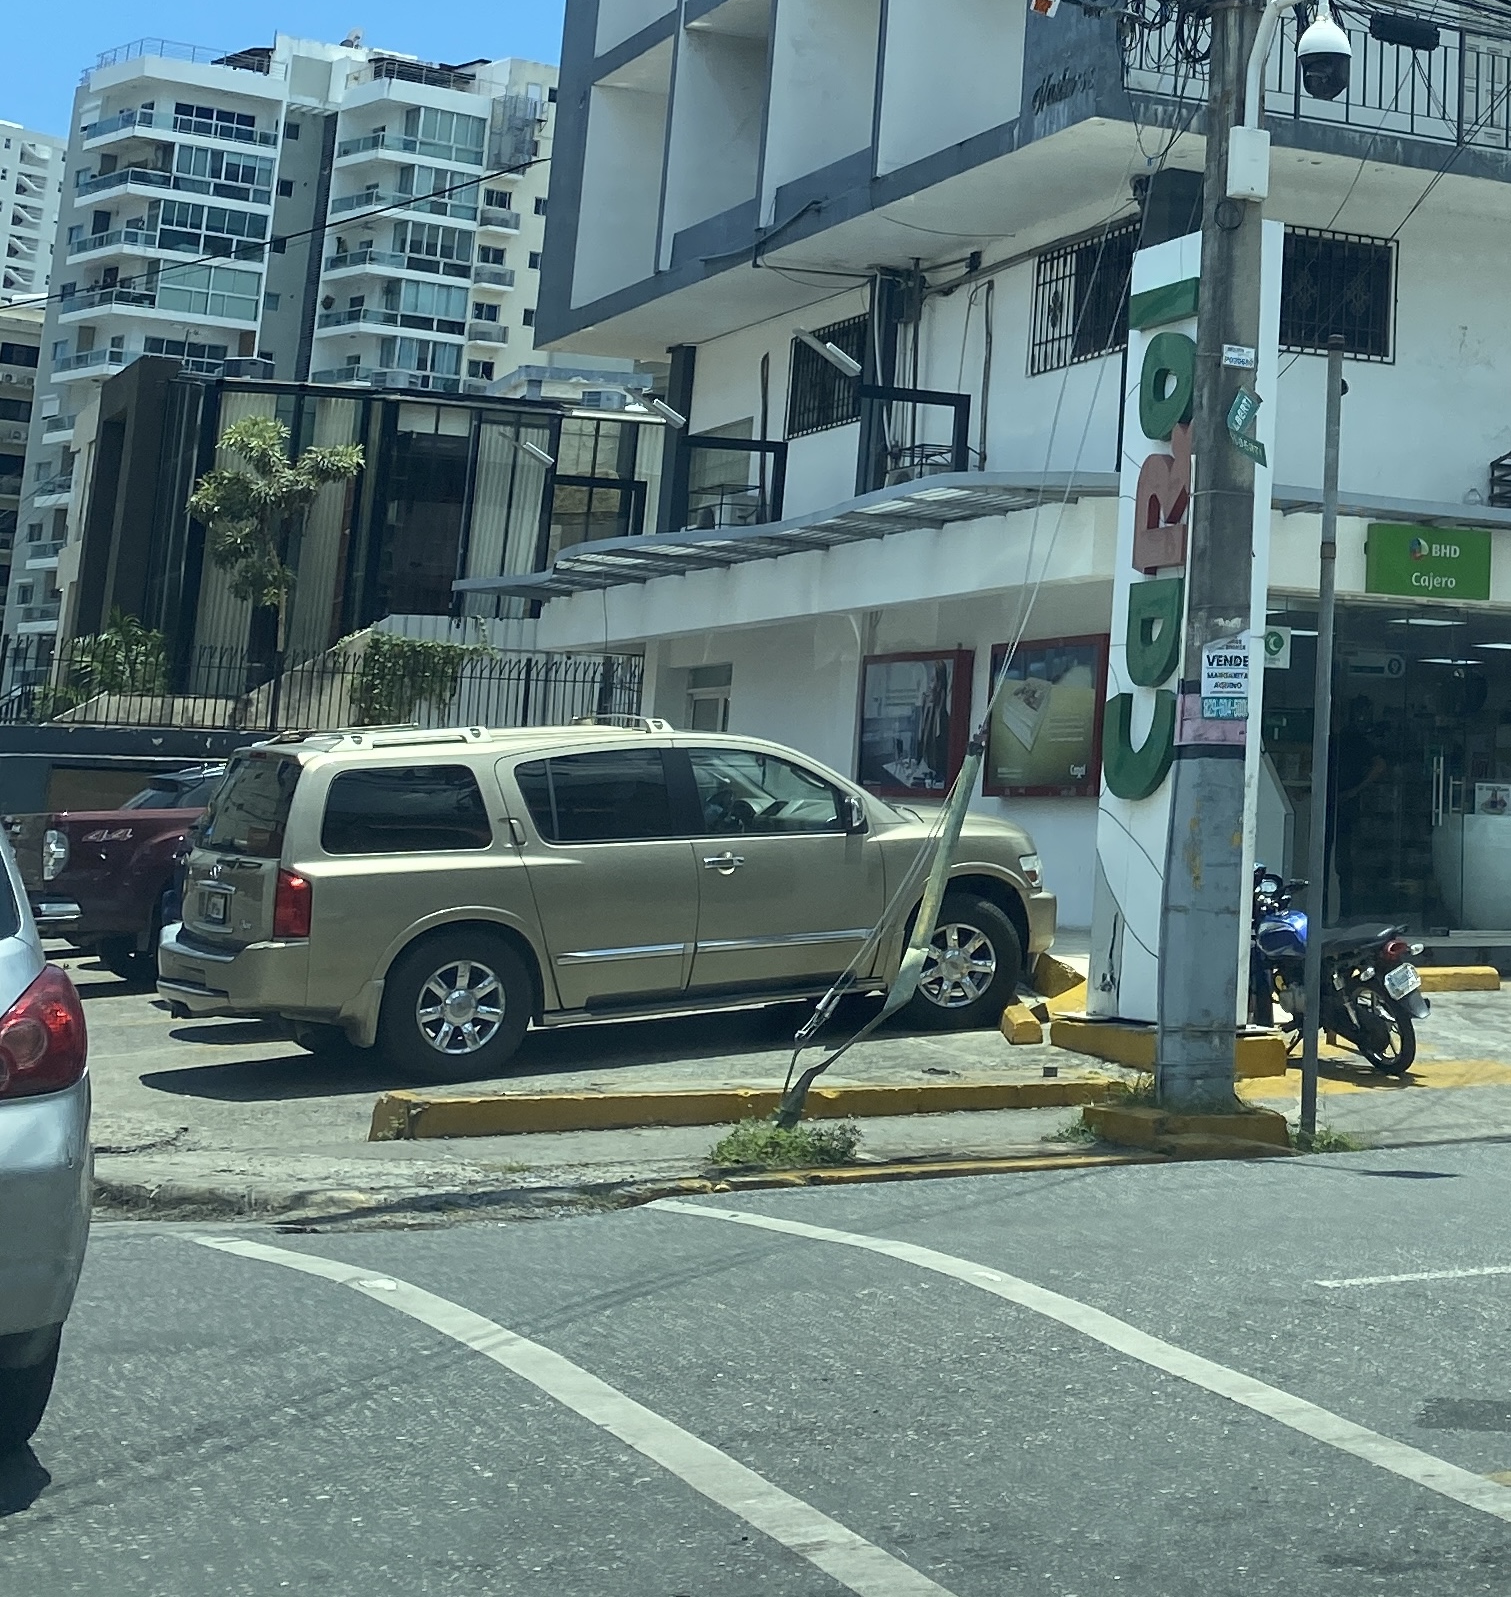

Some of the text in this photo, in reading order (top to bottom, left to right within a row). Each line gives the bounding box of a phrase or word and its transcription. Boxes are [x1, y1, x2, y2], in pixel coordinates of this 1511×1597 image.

[1431, 543, 1460, 559] BHD
[1411, 571, 1456, 591] Cajero
[1206, 654, 1249, 667] VENDE
